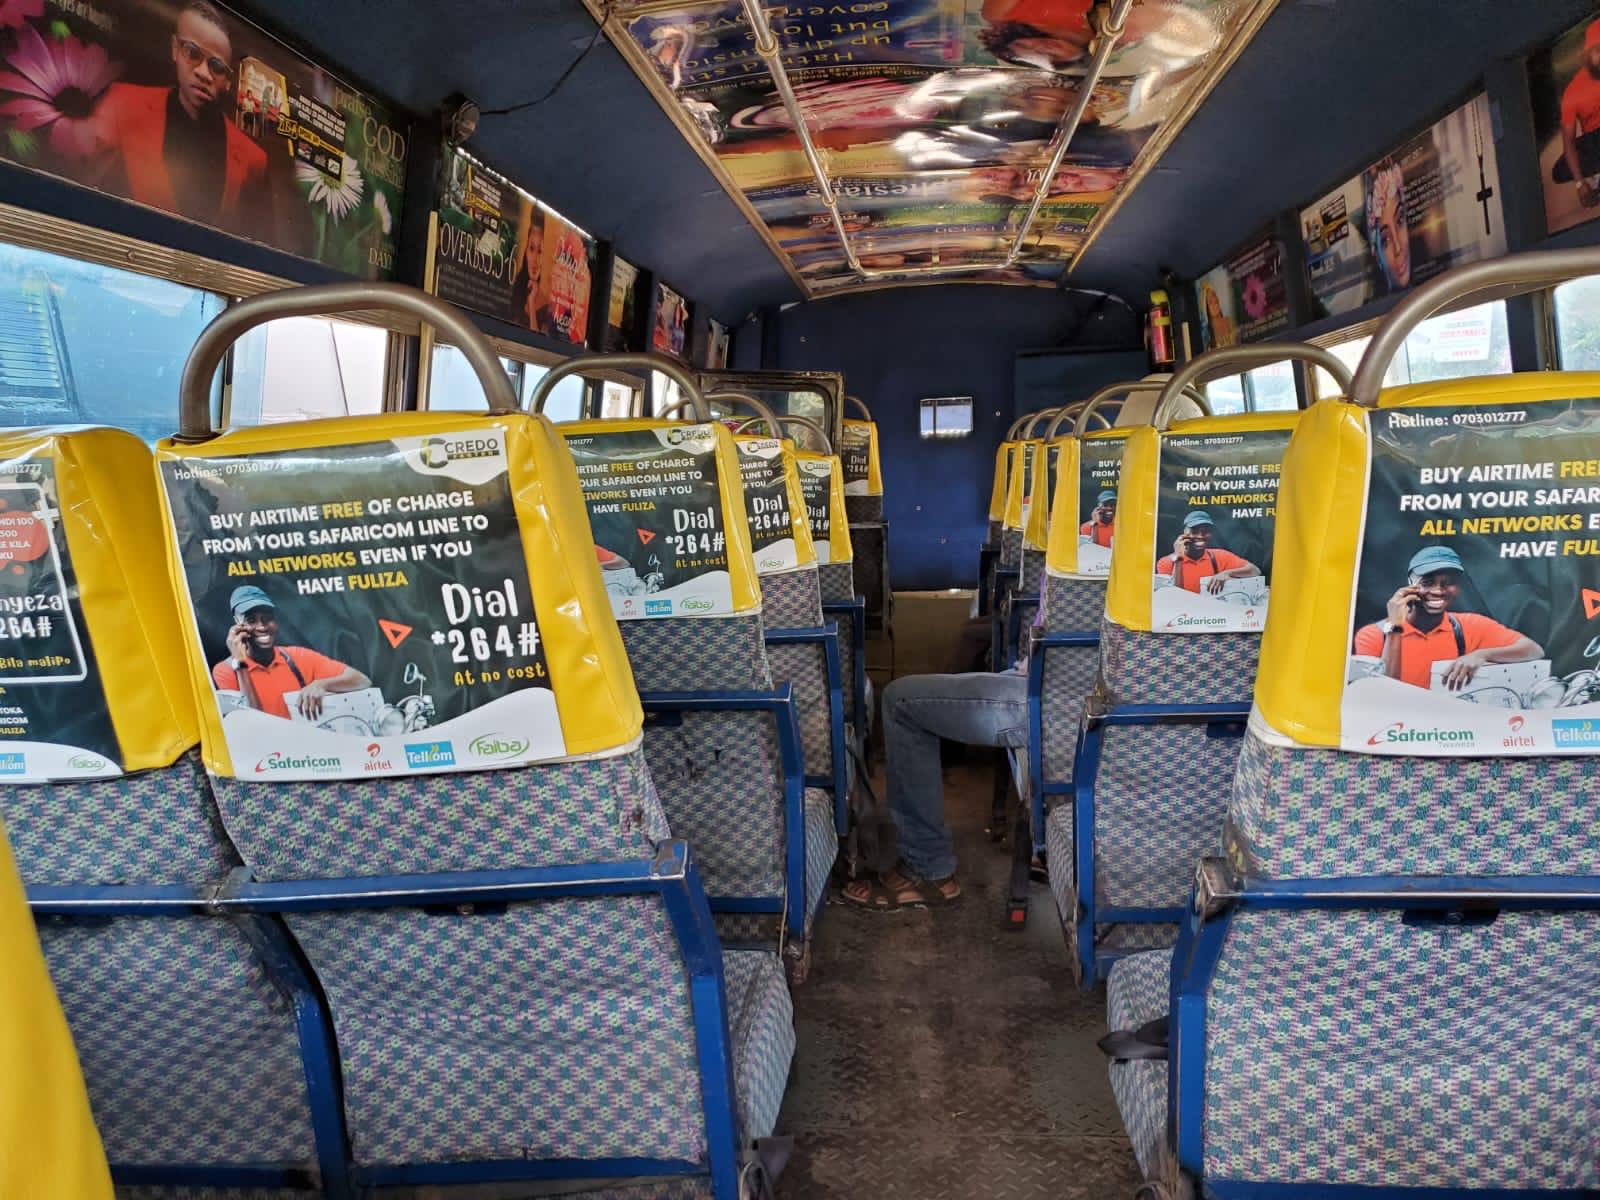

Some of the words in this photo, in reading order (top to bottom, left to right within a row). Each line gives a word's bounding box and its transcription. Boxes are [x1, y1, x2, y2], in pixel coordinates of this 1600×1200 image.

[831, 19, 890, 33] but
[851, 35, 891, 46] up
[743, 51, 853, 72] Hatrd
[363, 115, 406, 162] GOD
[1388, 412, 1449, 429] Hotline:
[444, 438, 499, 454] CREDO
[611, 462, 634, 473] FREE
[636, 461, 651, 471] OF
[652, 457, 696, 470] CHARGE
[1098, 459, 1115, 468] BUY
[1186, 467, 1211, 477] BUY
[1213, 464, 1259, 477] AIRTIME
[1420, 466, 1465, 485] BUY
[1467, 462, 1554, 483] AIRTIME
[1559, 459, 1600, 479] FRE
[174, 465, 223, 480] Hotline:
[601, 474, 662, 487] SAFARICOM
[664, 472, 686, 482] LINE
[687, 470, 703, 480] TO
[762, 469, 773, 478] TO
[1091, 470, 1115, 478] FROM
[630, 487, 656, 499] EVEN
[659, 487, 668, 497] IF
[669, 485, 693, 496] YOU
[750, 480, 767, 489] YOU
[1176, 481, 1211, 491] FROM
[1213, 480, 1246, 491] YOUR
[752, 494, 783, 515] Dial
[1188, 496, 1208, 505] ALL
[1211, 492, 1275, 504] NETWORKS
[1400, 492, 1462, 512] FROM
[1468, 490, 1529, 509] YOUR
[209, 511, 244, 530] BUY
[250, 504, 320, 526] AIRTIME
[322, 500, 364, 520] FREE
[367, 498, 392, 516] OF
[396, 490, 475, 513] CHARGE
[593, 503, 620, 514] HAVE
[622, 501, 657, 512] FULIZA
[1232, 507, 1263, 519] HAVE
[673, 506, 715, 533] Dial
[1420, 519, 1457, 537] ALL
[1461, 514, 1583, 534] NETWORKS
[202, 536, 252, 555] FROM
[254, 532, 306, 551] YOUR
[308, 520, 415, 546] SAFARICOM
[418, 517, 460, 537] LINE
[462, 514, 489, 532] TO
[1500, 540, 1558, 559] HAVE
[227, 559, 256, 577] ALL
[258, 551, 357, 574] NETWORKS
[359, 547, 408, 566] EVEN
[411, 545, 428, 561] IF
[430, 540, 473, 560] YOU
[297, 576, 345, 595] HAVE
[347, 570, 408, 591] FULIZA
[441, 578, 519, 625] Dial
[1177, 616, 1227, 626] Safaricom
[454, 669, 475, 686] At
[481, 671, 500, 683] no
[507, 662, 546, 680] cost
[1387, 728, 1474, 743] Safaricom
[1503, 735, 1537, 747] airtel
[267, 755, 341, 770] Safaricom
[363, 759, 393, 772] airtel
[407, 748, 453, 764] Telkom
